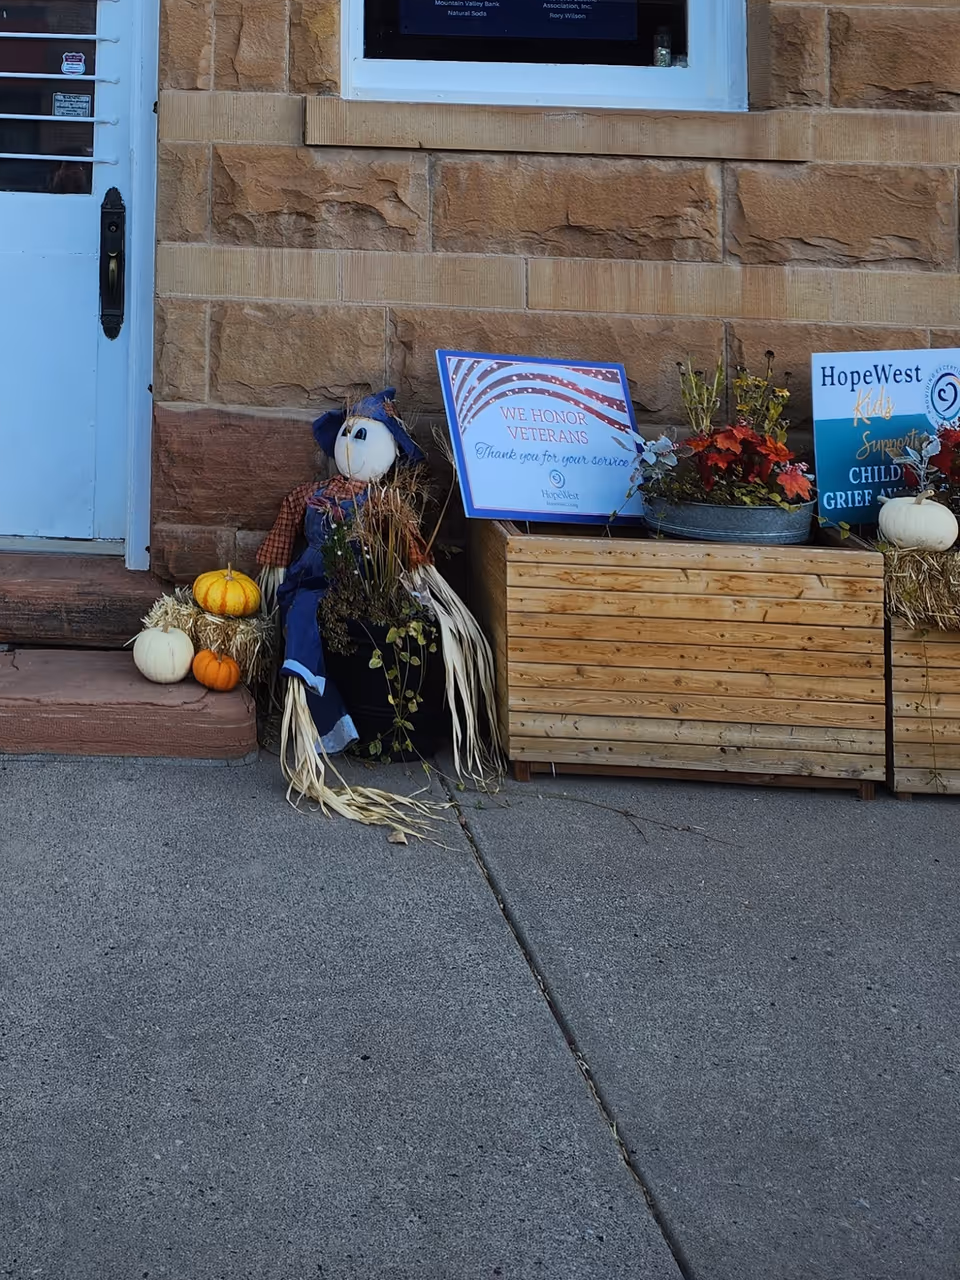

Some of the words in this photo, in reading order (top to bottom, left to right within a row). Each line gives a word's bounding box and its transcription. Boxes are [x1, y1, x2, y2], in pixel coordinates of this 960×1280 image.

[820, 364, 922, 393] HopeWest
[500, 406, 528, 422] WE
[531, 408, 588, 426] HONOR
[854, 385, 896, 427] Kids
[506, 426, 589, 446] VETERANS
[475, 442, 516, 460] Thank
[520, 452, 539, 465] you
[540, 450, 558, 466] for
[562, 456, 590, 468] your
[541, 489, 580, 502] HopeWest
[823, 489, 873, 510] GRIEF
